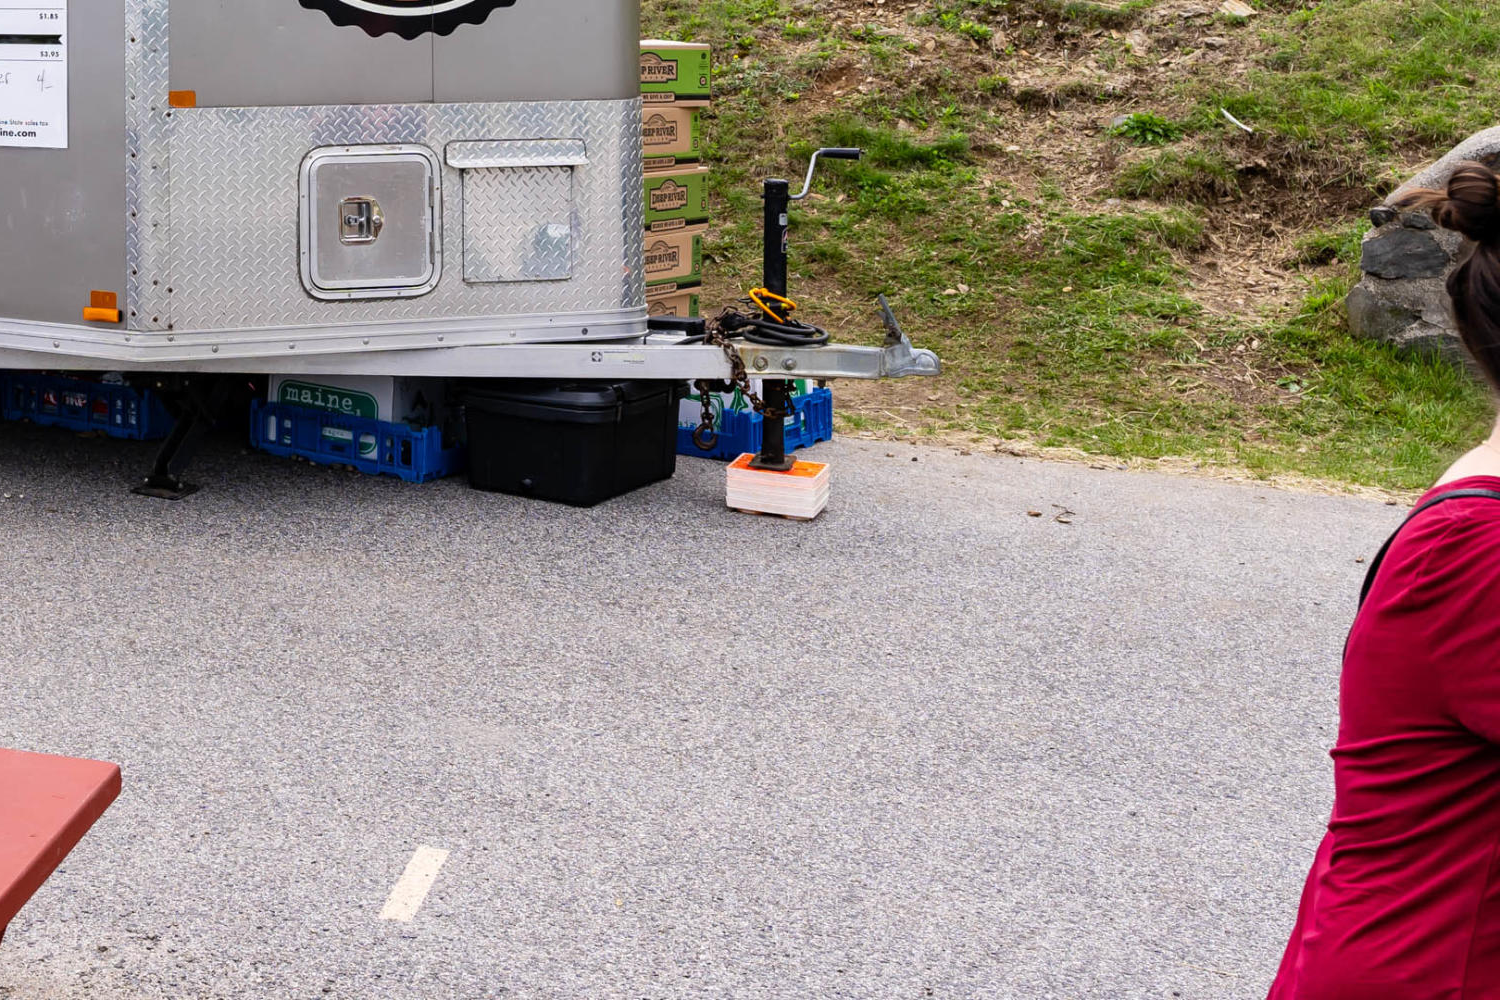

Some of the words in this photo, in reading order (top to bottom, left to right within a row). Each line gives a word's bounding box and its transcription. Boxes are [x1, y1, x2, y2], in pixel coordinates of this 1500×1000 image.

[648, 65, 675, 75] RIVER
[643, 128, 656, 137] EEP
[656, 126, 676, 137] RIVER
[652, 193, 668, 204] DEEP
[668, 191, 686, 201] RIVER
[645, 255, 657, 265] EEP
[658, 251, 677, 264] RIVER
[285, 386, 353, 411] maine
